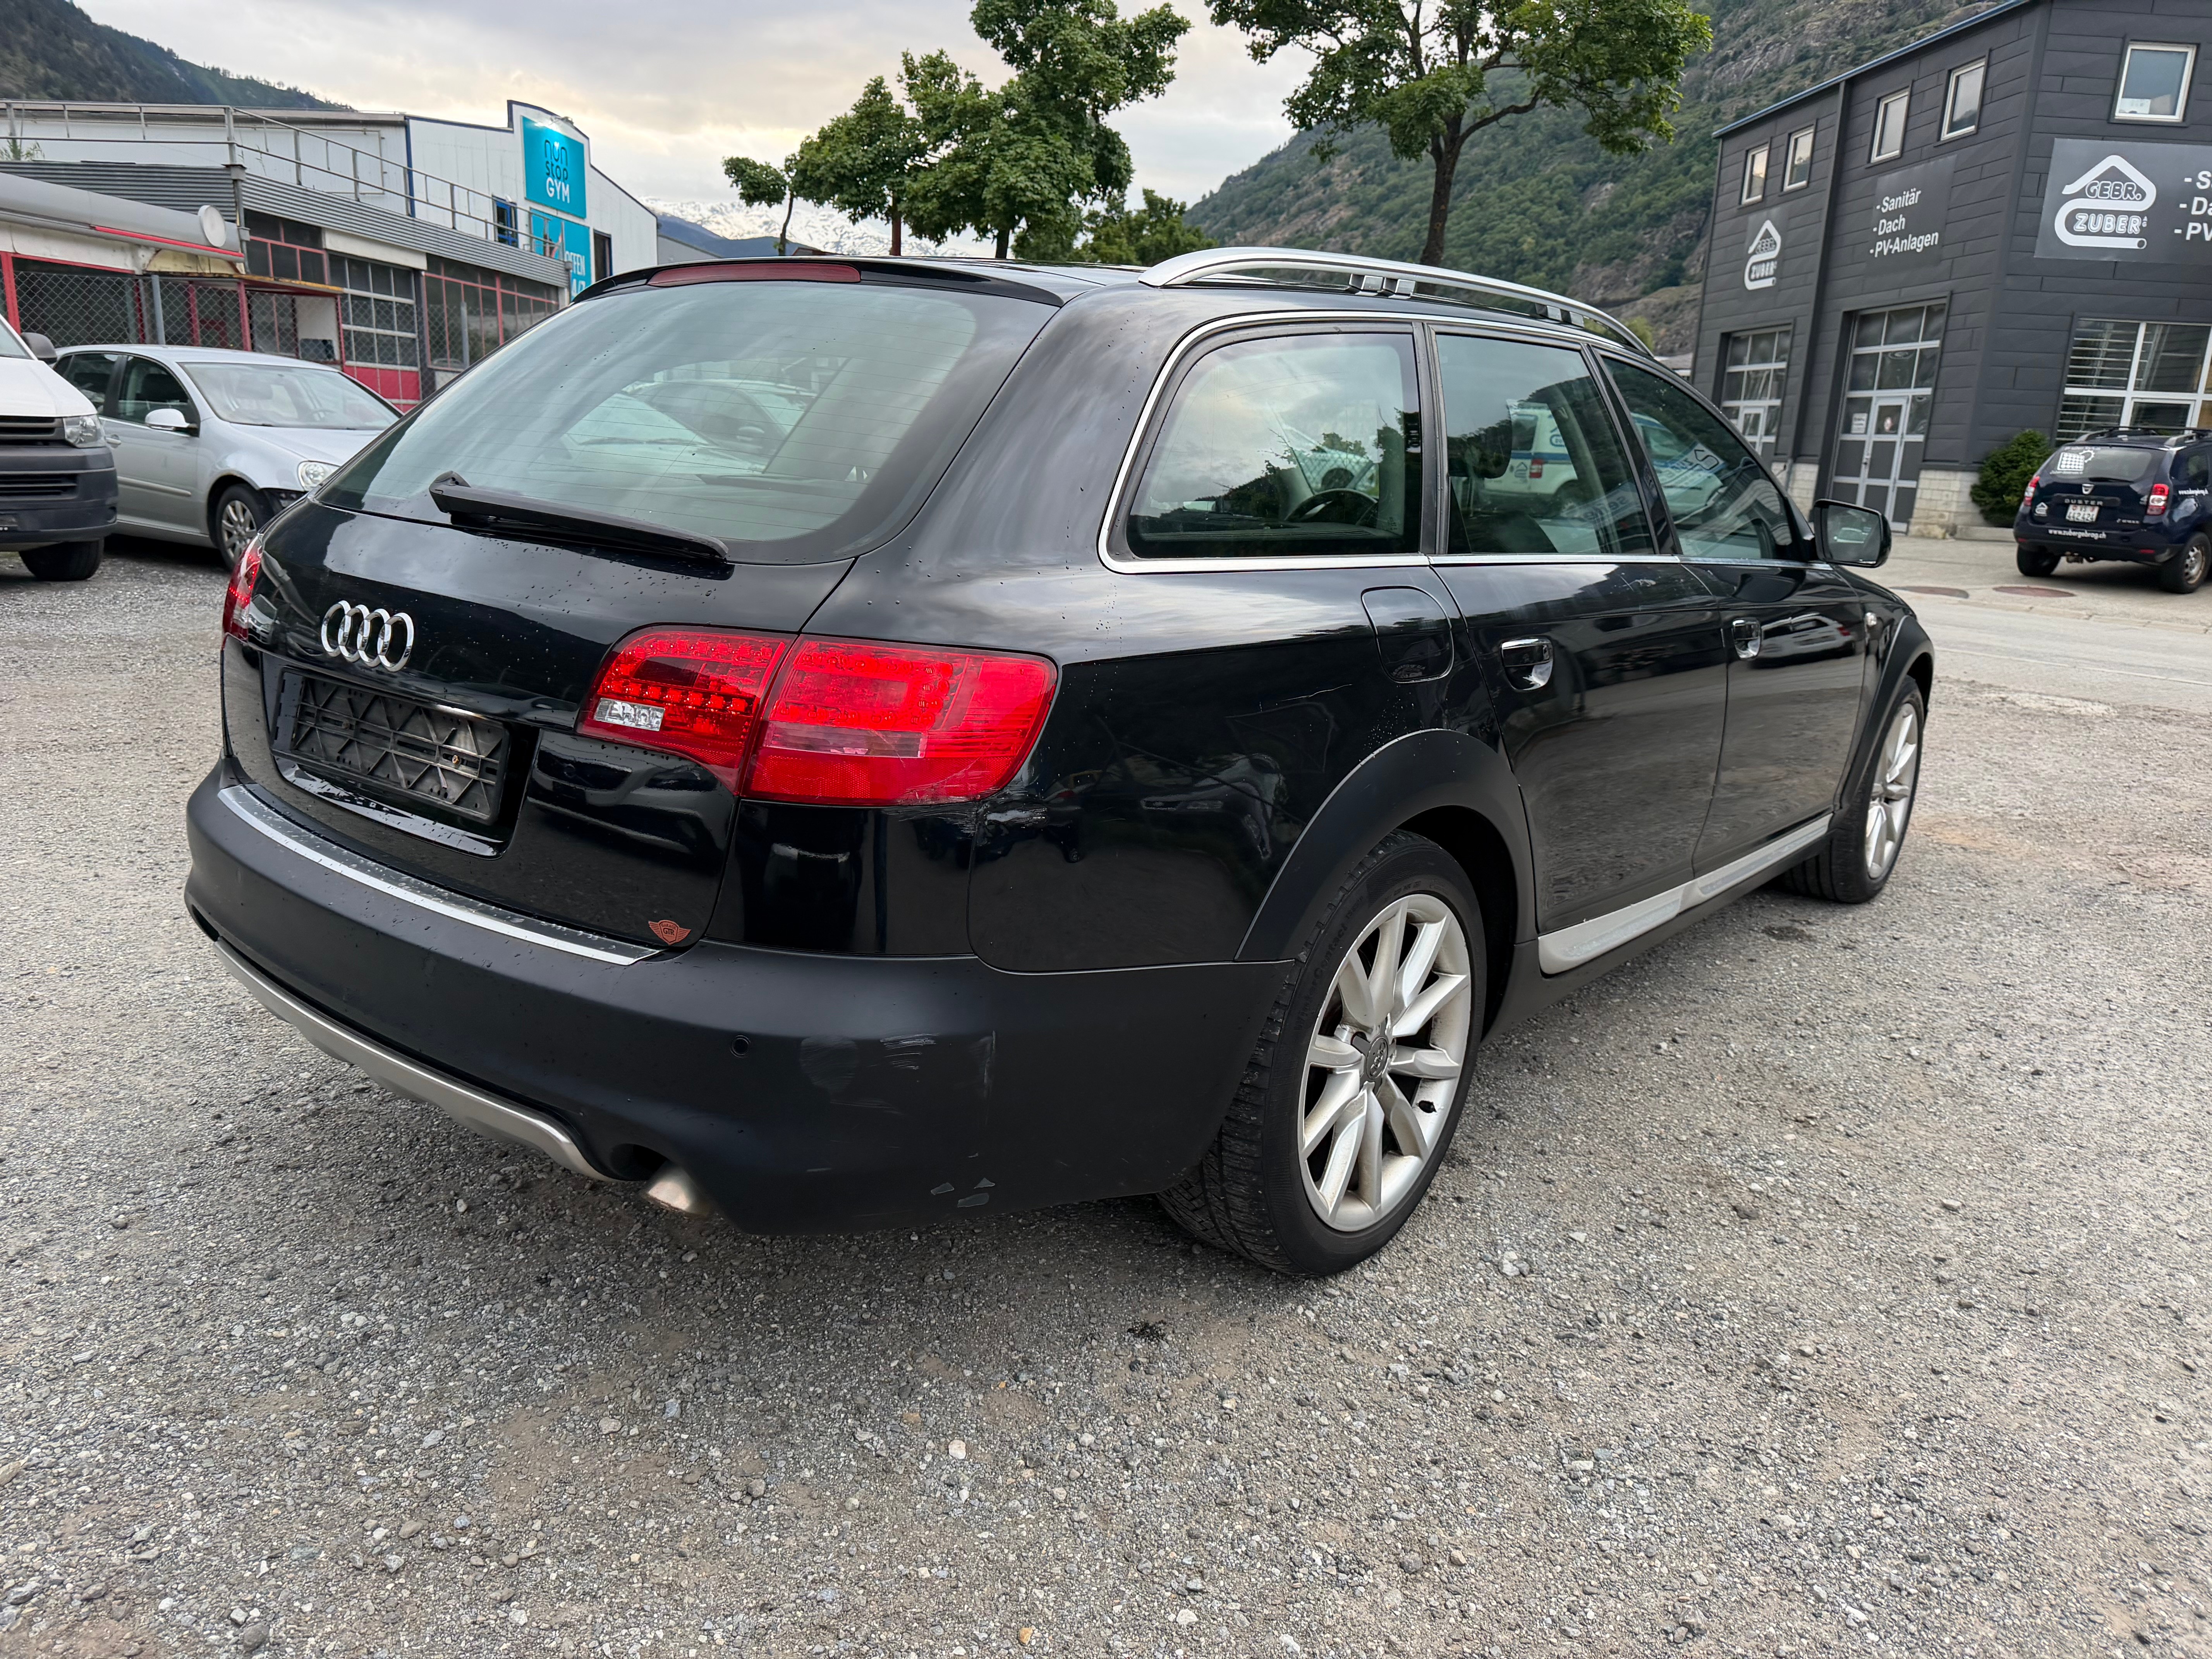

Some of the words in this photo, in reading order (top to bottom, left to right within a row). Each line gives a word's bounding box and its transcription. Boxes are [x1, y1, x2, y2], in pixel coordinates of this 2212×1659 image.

[544, 139, 568, 167] non
[545, 160, 568, 182] stop
[546, 177, 570, 204] GYM
[2085, 180, 2142, 200] GEBR.
[2073, 213, 2142, 235] ZUBER
